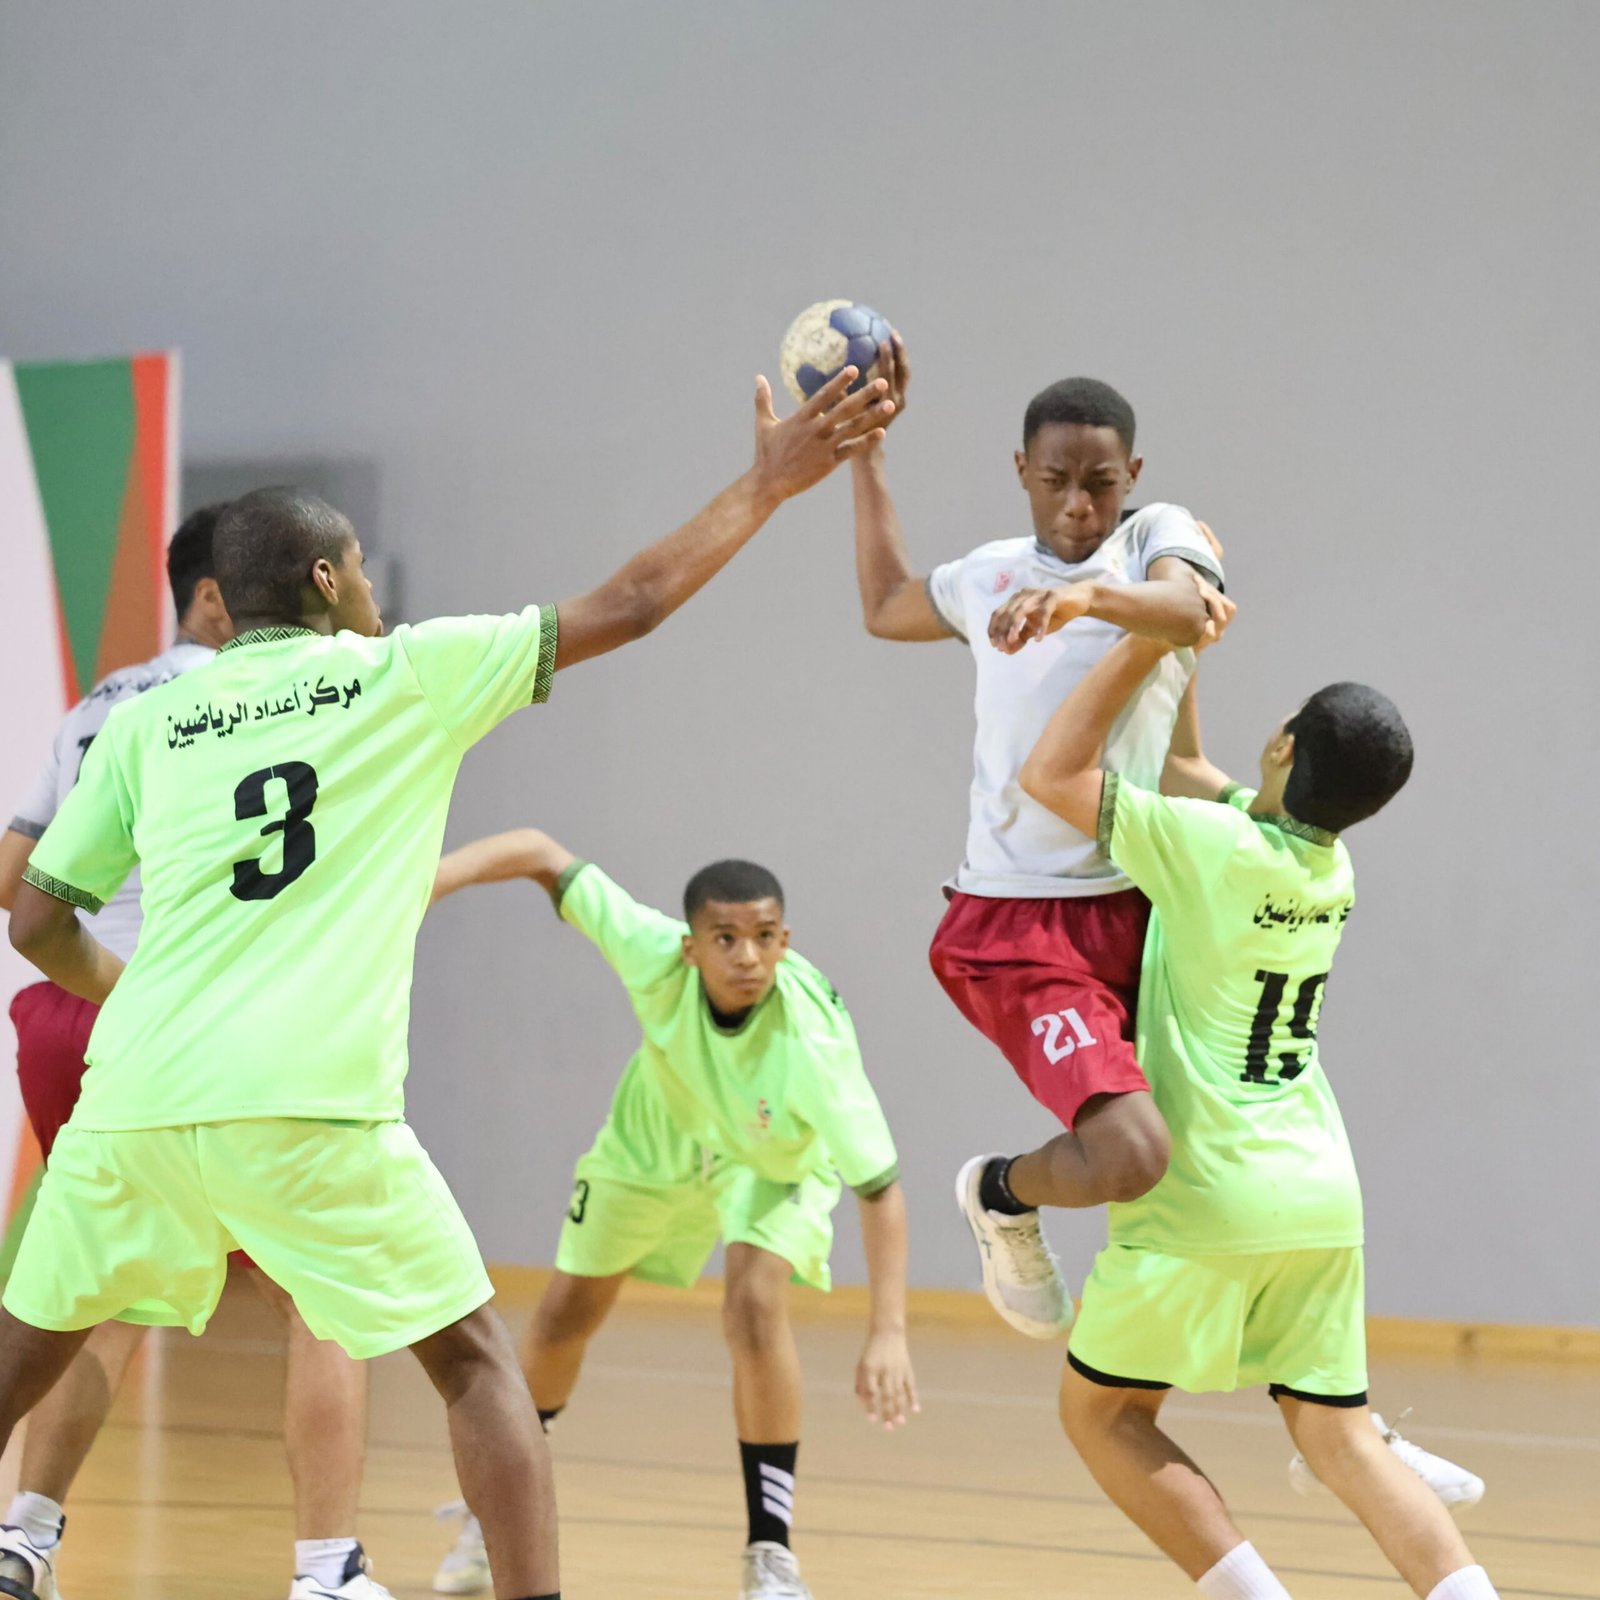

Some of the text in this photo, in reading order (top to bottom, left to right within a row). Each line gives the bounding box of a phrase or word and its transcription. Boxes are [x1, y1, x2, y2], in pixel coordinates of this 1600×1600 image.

[303, 675, 362, 717] مركز
[167, 701, 249, 750] الرياضيين
[229, 760, 320, 902] 3
[1030, 1007, 1098, 1066] 21
